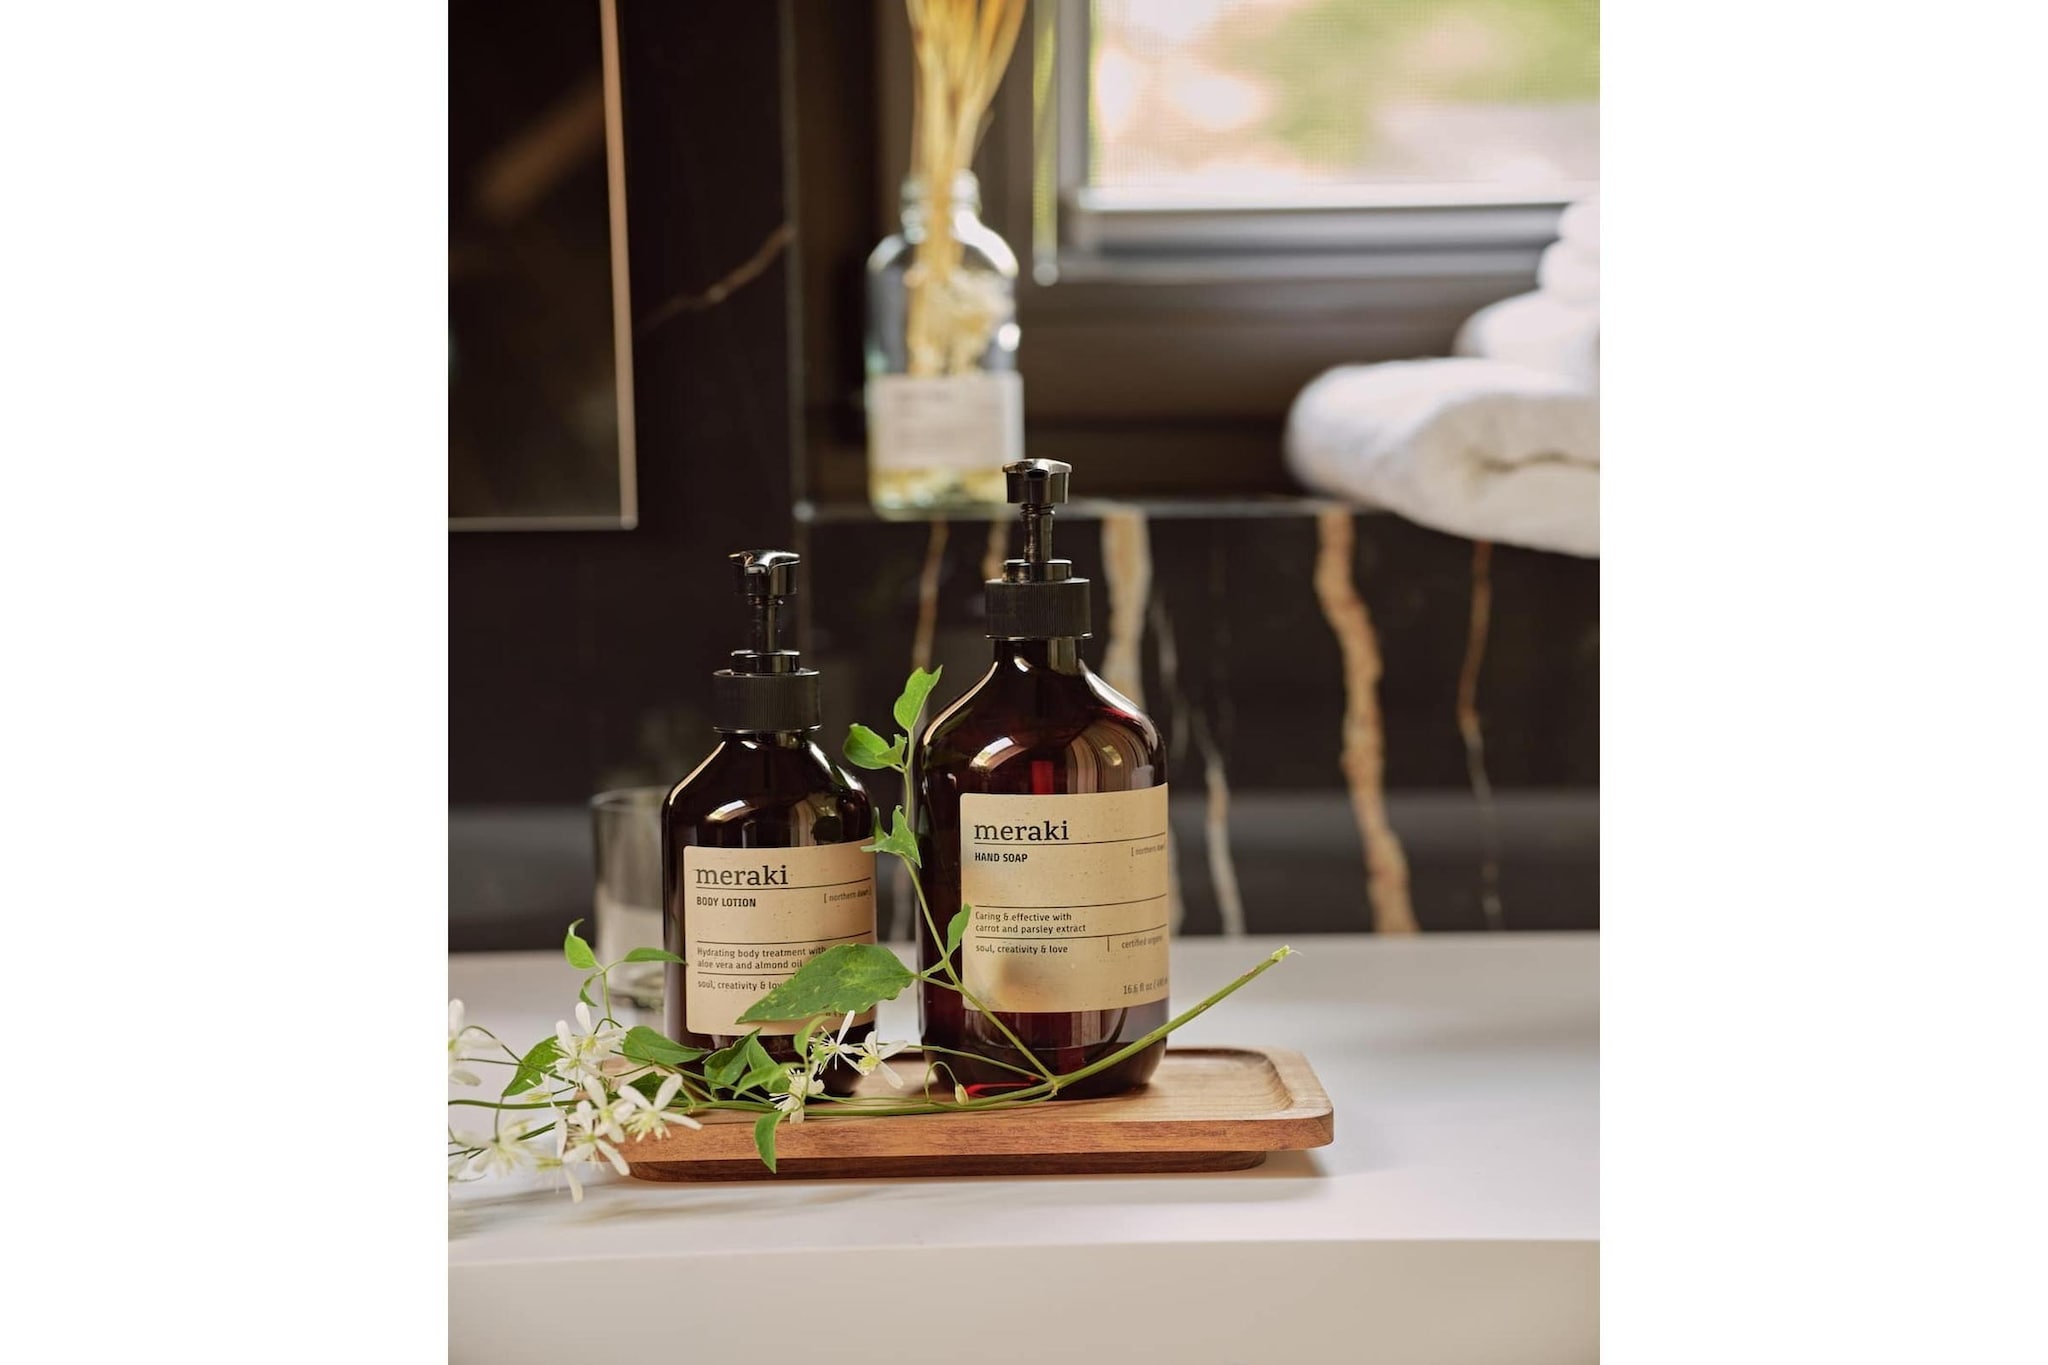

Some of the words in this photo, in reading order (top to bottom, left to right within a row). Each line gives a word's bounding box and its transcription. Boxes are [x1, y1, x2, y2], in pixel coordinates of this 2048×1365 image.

[974, 820, 1070, 841] meraki
[974, 852, 1000, 862] HAND
[1002, 852, 1028, 863] SOAP
[695, 864, 789, 886] meraki
[696, 896, 718, 908] BODY
[721, 897, 756, 908] LOTION
[975, 912, 1001, 923] Caring
[1003, 912, 1009, 921] &
[1011, 913, 1050, 922] effective
[1053, 912, 1072, 921] with
[975, 925, 1000, 933] carrot
[1002, 924, 1018, 934] and
[1021, 924, 1054, 936] parsley
[1056, 924, 1086, 933] extract
[697, 946, 736, 959] Hydrating
[737, 949, 760, 960] body
[762, 949, 806, 958] treatment
[975, 944, 995, 954] soul,
[997, 944, 1038, 955] creativity
[1041, 945, 1046, 953] &
[1049, 944, 1068, 953] love
[697, 959, 714, 968] aloe
[735, 961, 753, 970] and
[755, 960, 789, 969] almond
[791, 959, 803, 968] oil
[717, 981, 758, 991] creativity
[760, 981, 766, 990] &
